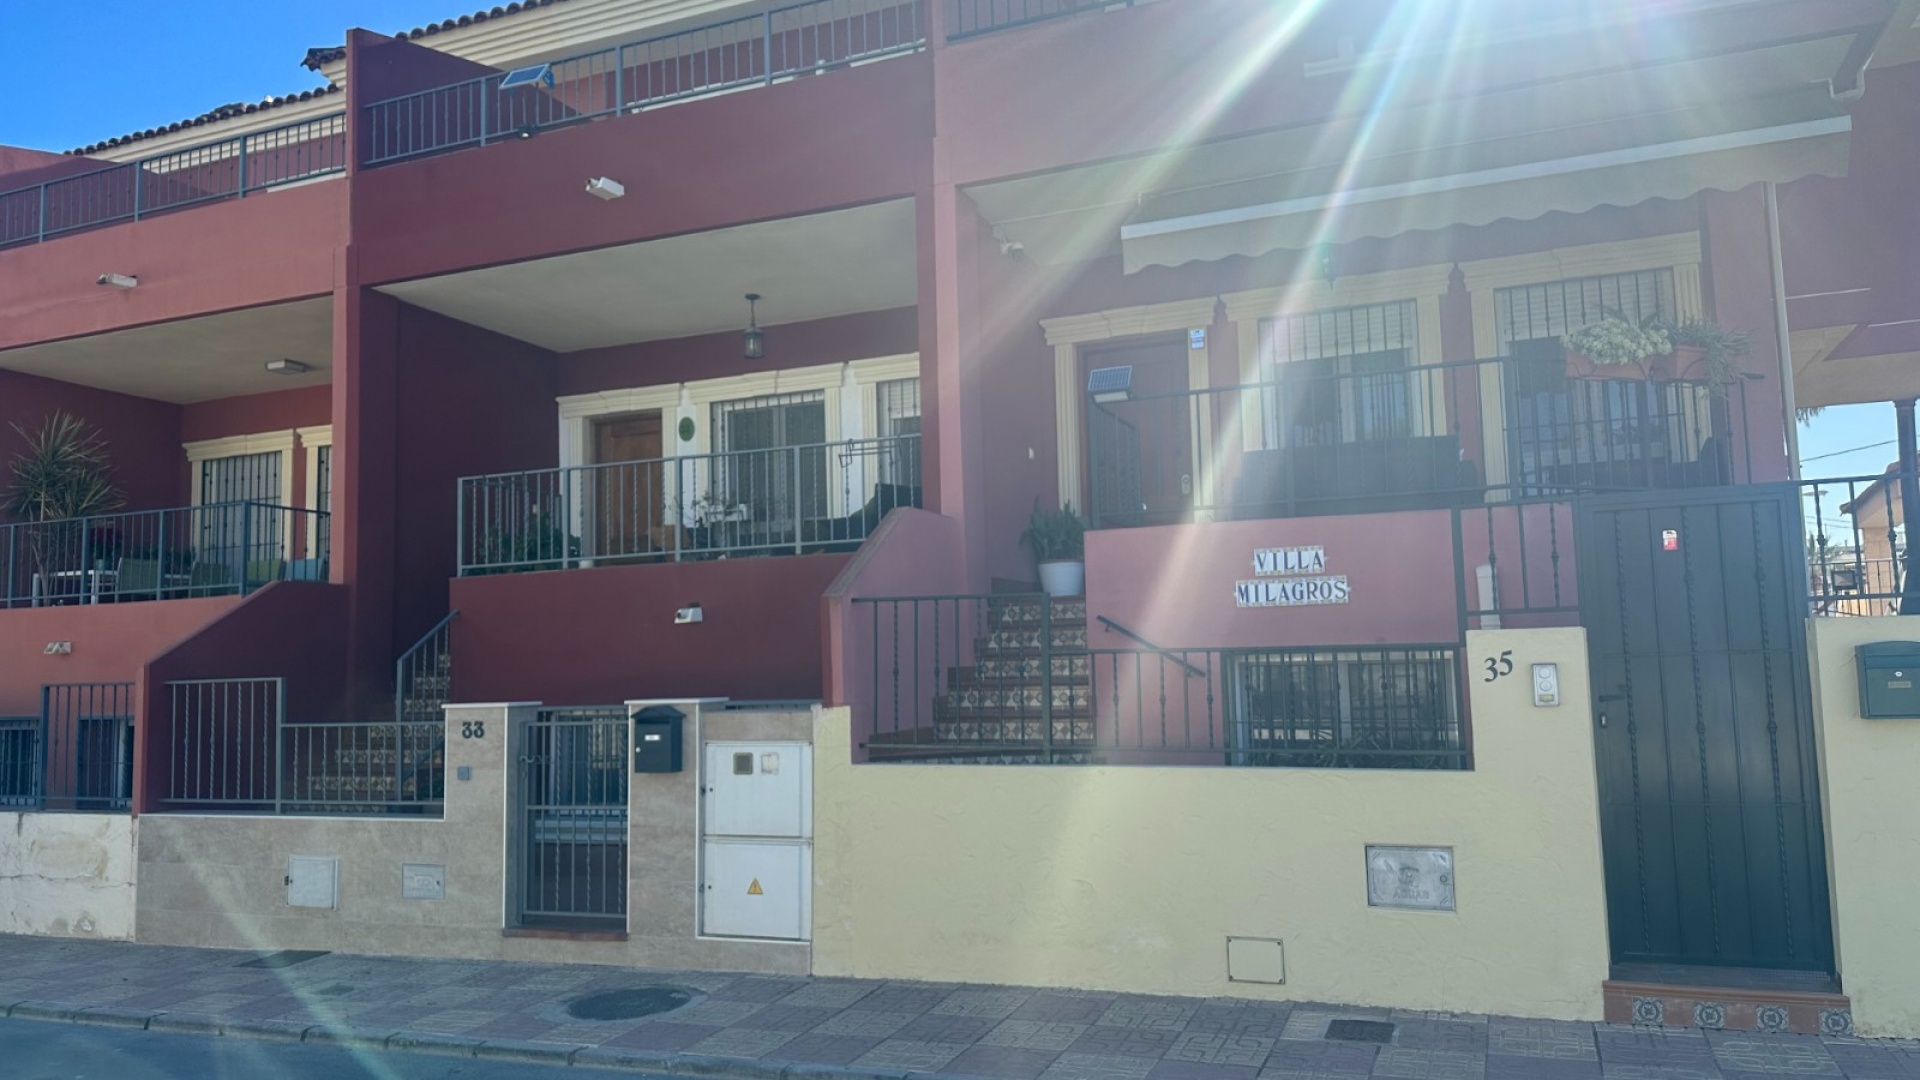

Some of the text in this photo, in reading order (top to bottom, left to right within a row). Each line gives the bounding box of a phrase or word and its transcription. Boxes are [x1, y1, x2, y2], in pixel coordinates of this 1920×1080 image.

[1256, 550, 1323, 571] VILLA
[1238, 580, 1347, 603] MILAGROS
[1484, 650, 1513, 682] 35
[462, 721, 485, 738] 33
